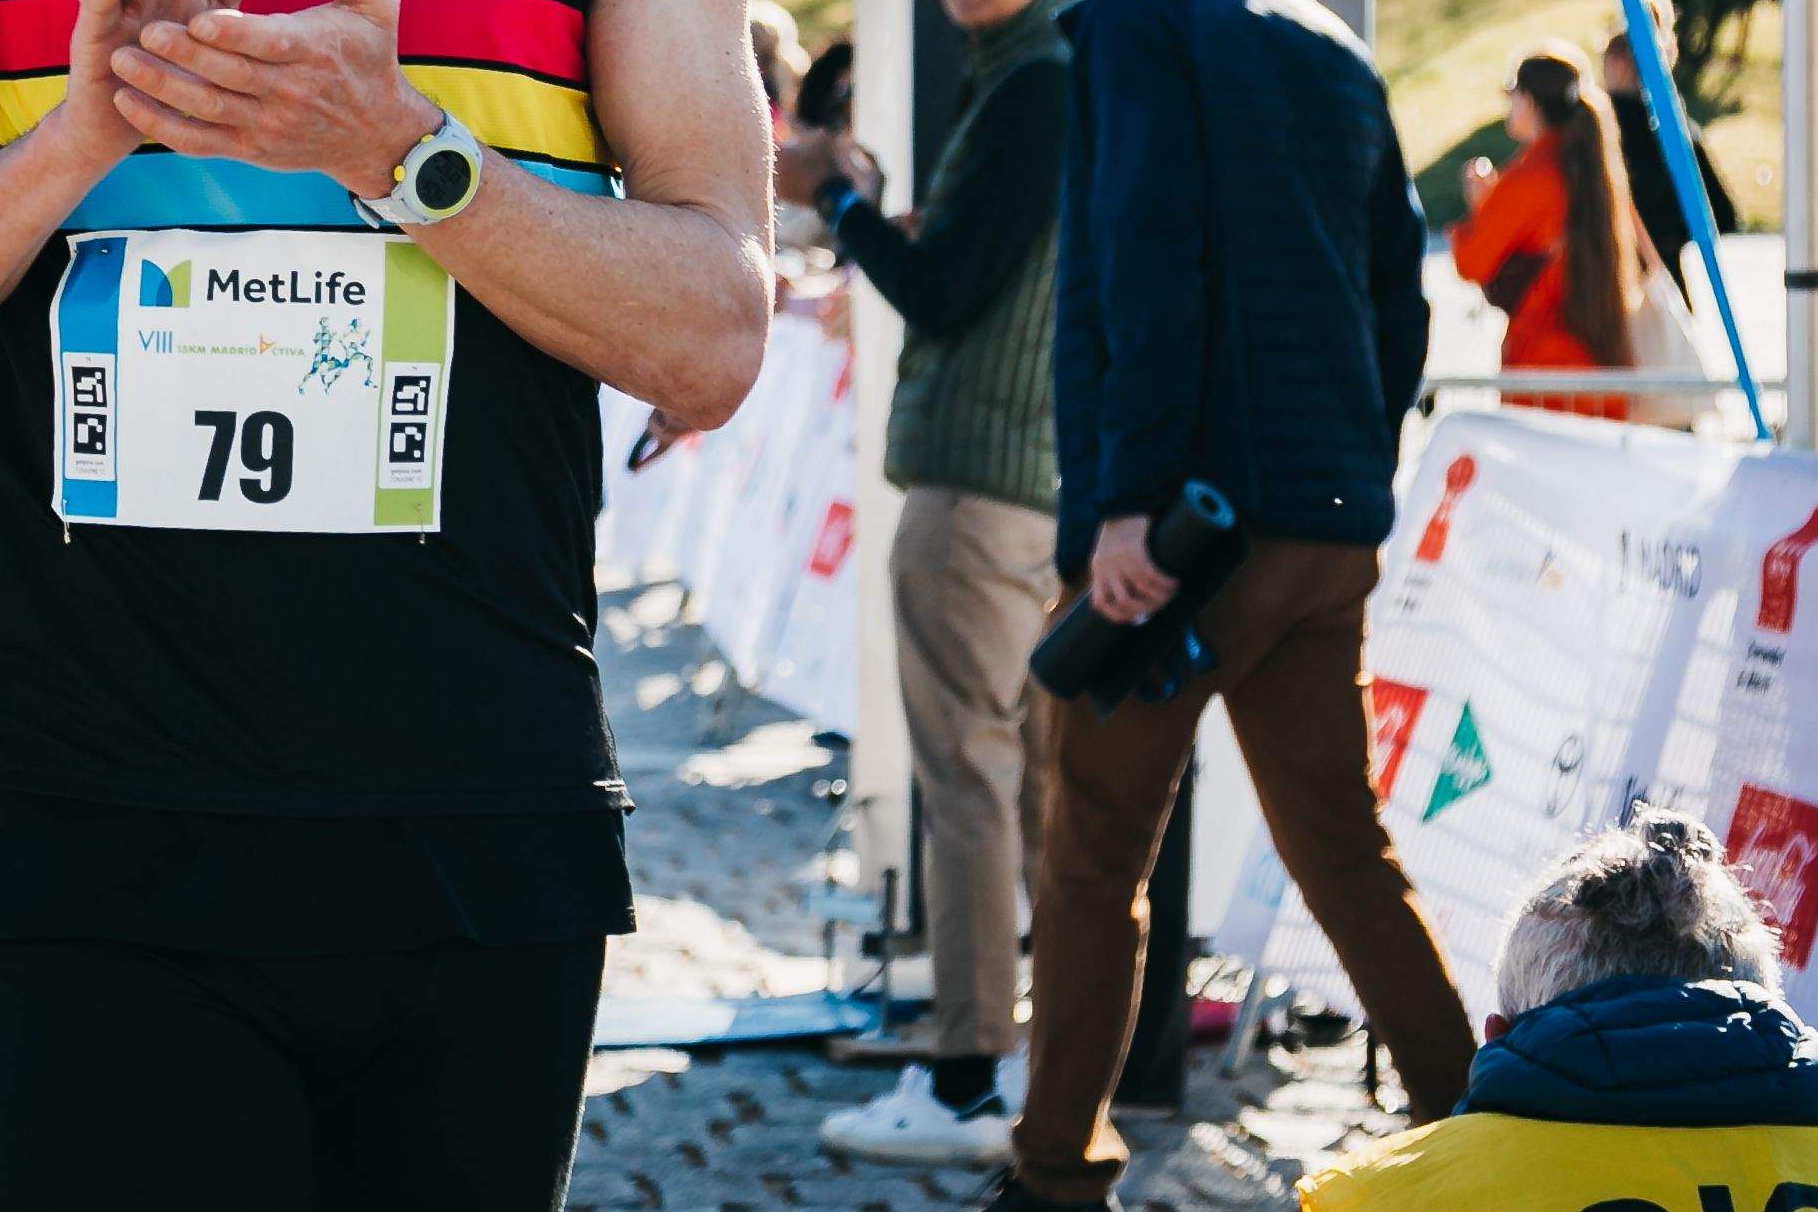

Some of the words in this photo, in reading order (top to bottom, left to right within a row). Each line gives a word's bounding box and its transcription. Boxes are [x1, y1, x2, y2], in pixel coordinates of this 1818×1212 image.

[206, 268, 366, 305] MetLife
[138, 330, 173, 353] VIII
[177, 344, 206, 355] 15KM
[194, 410, 294, 504] 79
